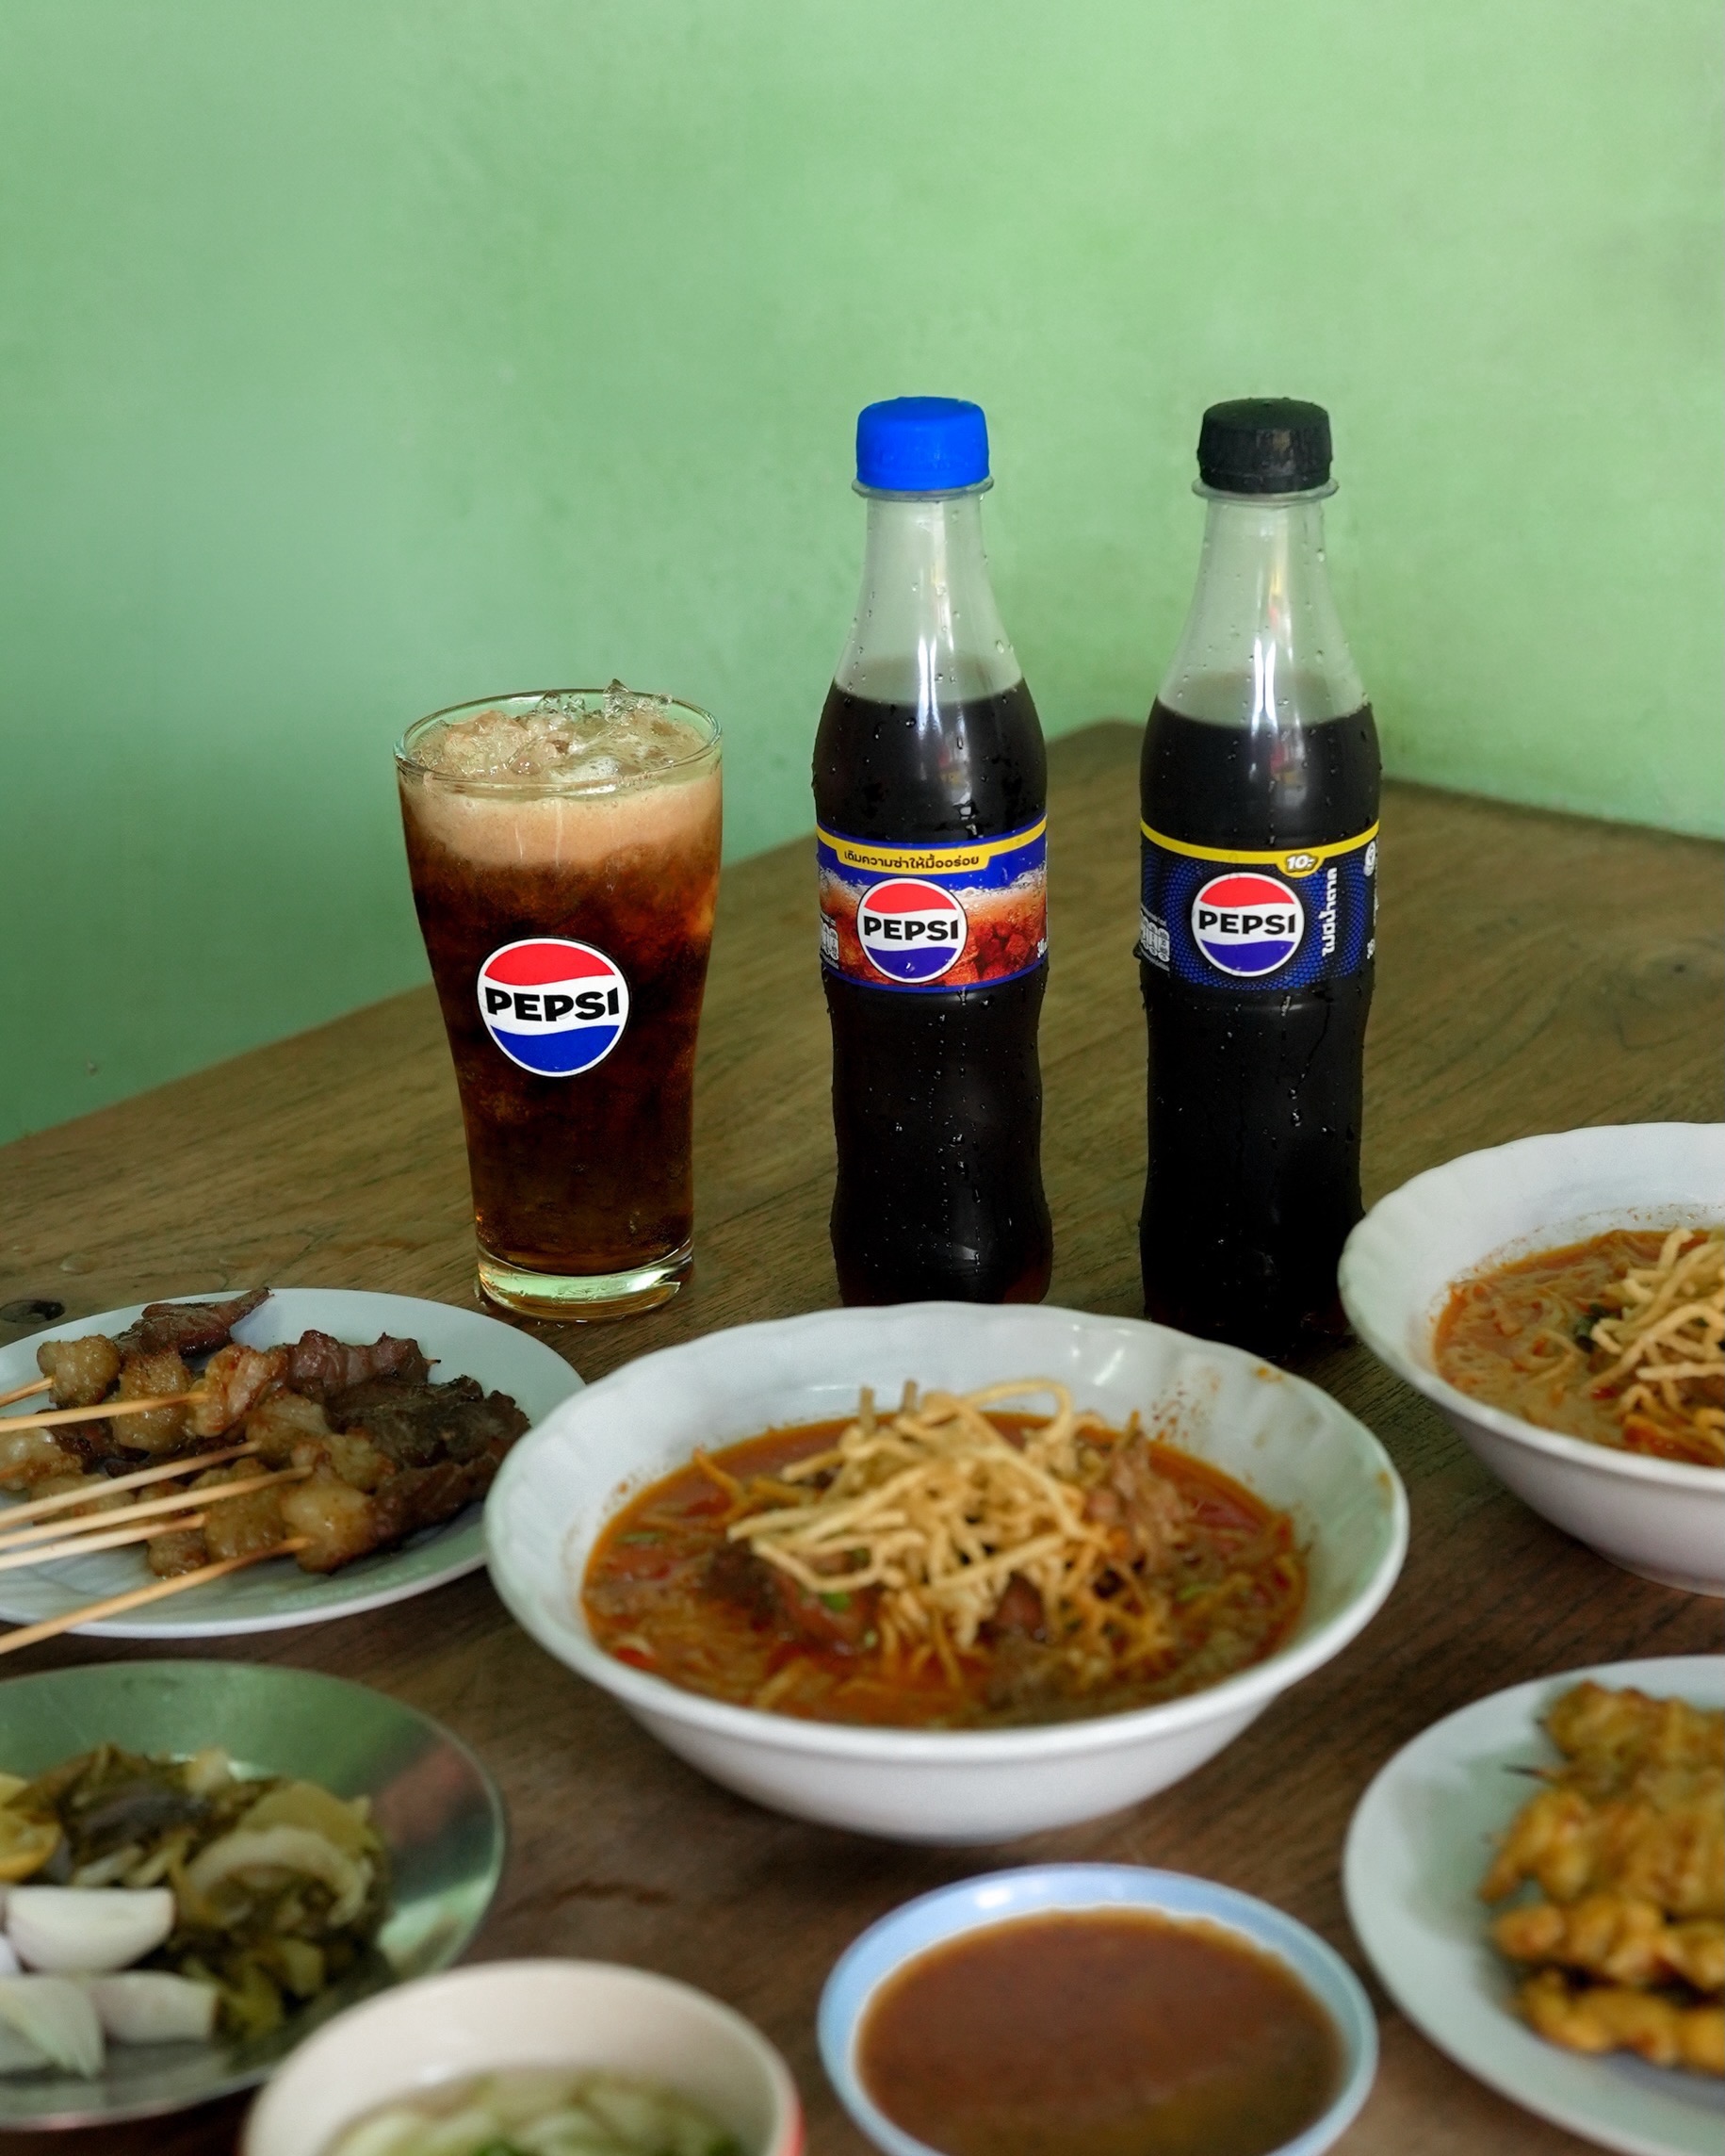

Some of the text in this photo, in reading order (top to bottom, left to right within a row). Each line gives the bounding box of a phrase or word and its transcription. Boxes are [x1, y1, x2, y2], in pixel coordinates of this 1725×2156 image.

[864, 916, 958, 940] PEPSI
[1199, 910, 1296, 935] PEPSI
[485, 987, 619, 1021] PEPSI
